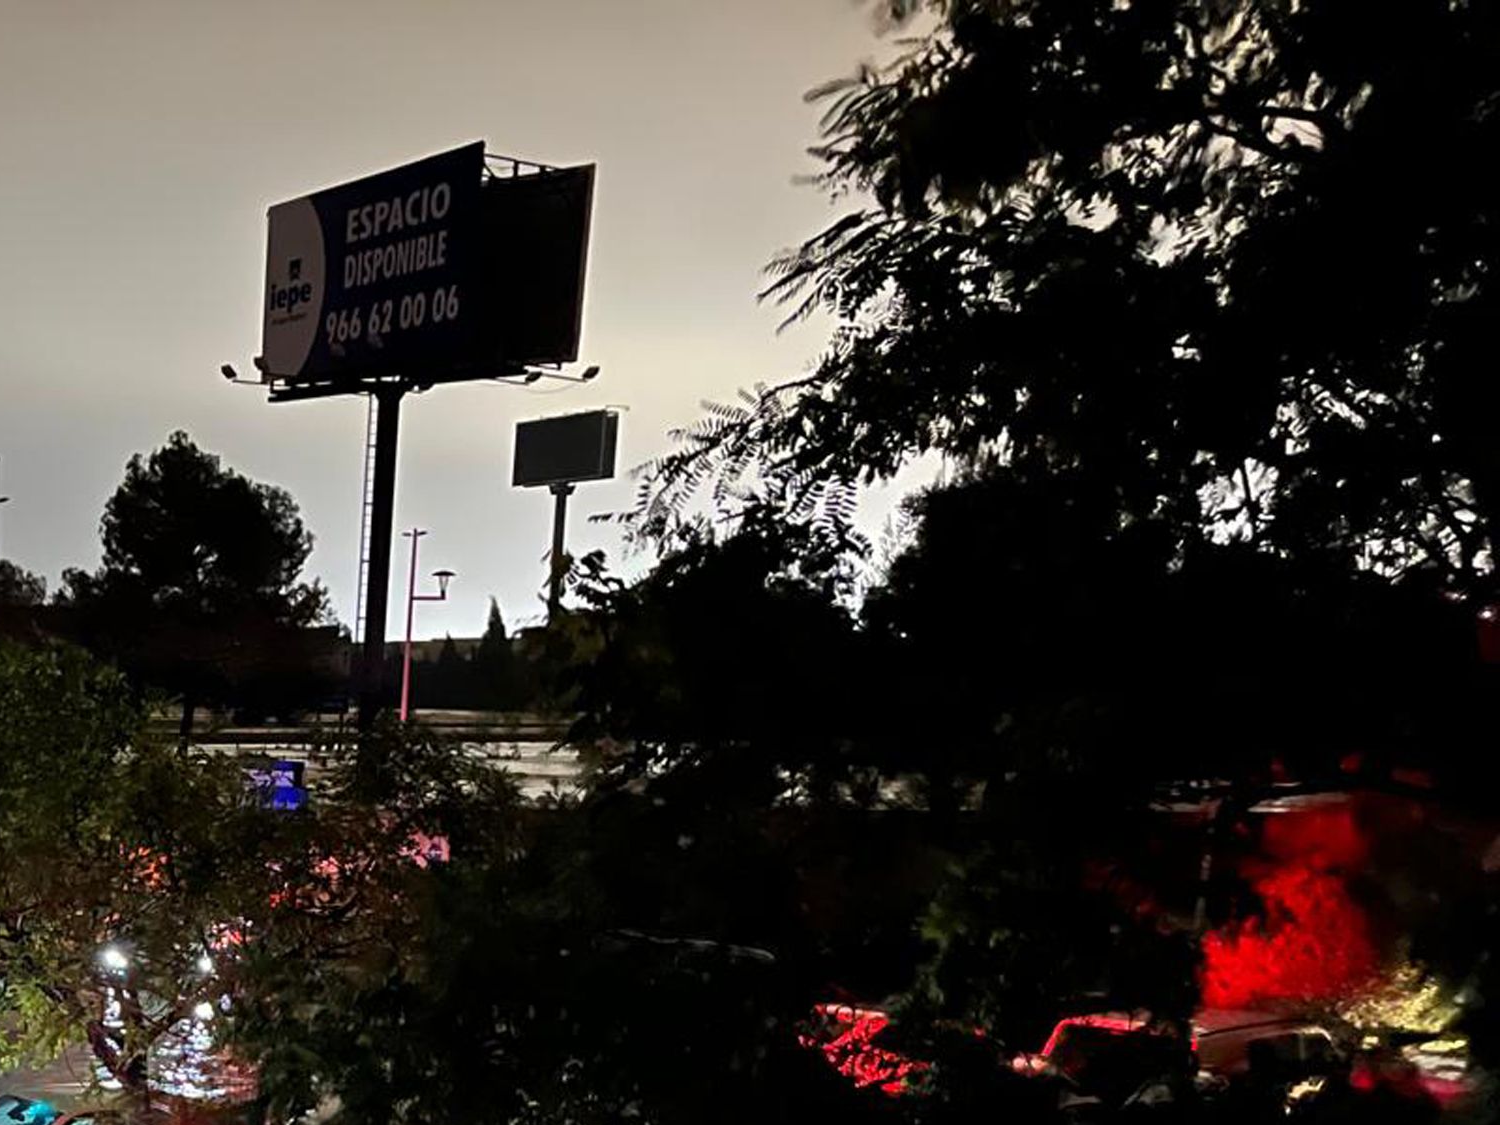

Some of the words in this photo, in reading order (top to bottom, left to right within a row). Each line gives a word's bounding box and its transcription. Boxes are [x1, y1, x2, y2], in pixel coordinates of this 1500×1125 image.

[346, 182, 451, 244] ESPACIO
[344, 230, 449, 289] DISPONIBLE
[270, 283, 312, 313] iepe
[326, 307, 362, 345] 966
[368, 299, 394, 334] 62
[400, 291, 427, 330] 00
[432, 284, 460, 323] 06
